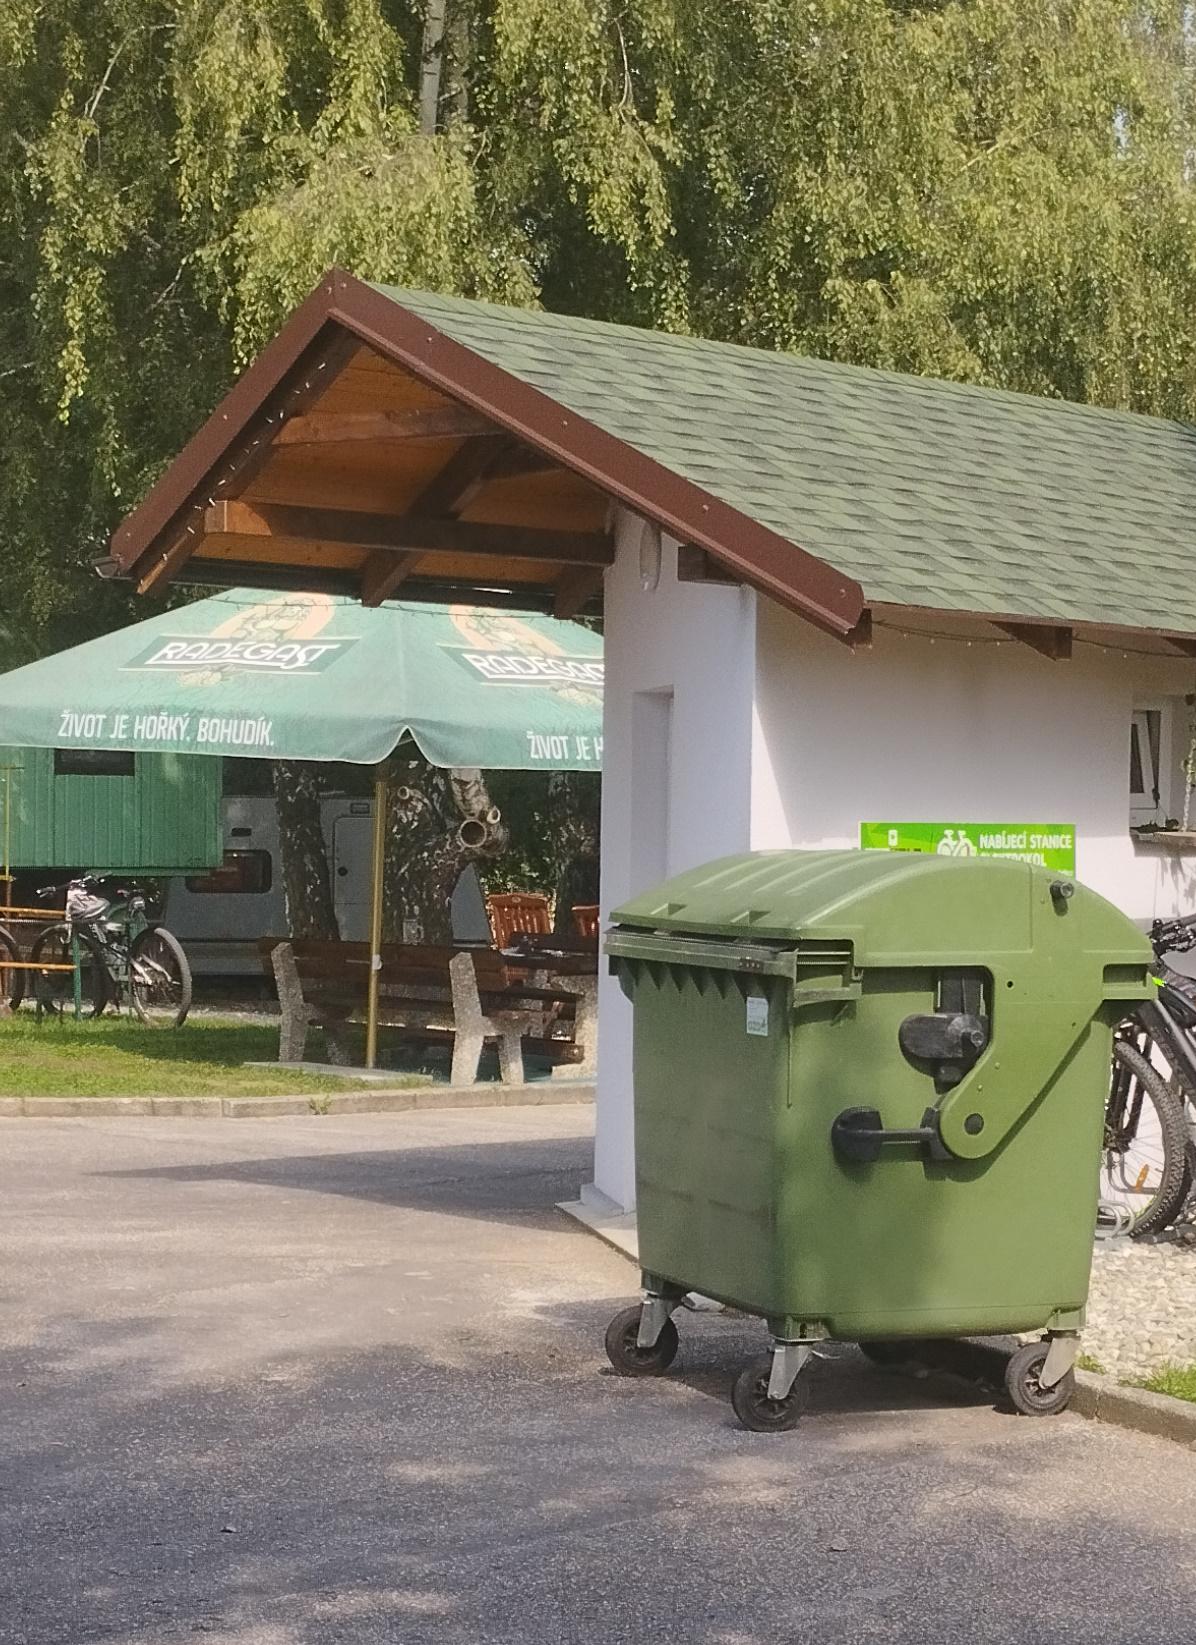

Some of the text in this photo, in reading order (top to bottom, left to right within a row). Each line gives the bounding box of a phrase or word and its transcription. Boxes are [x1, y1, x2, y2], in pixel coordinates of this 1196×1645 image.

[144, 642, 341, 670] RADEGAST
[461, 653, 604, 685] RADEGA
[58, 709, 274, 746] ŽIVOT JE HOŘKÝ. BOHUDÍK.
[526, 730, 568, 760] ŽIVOT
[576, 735, 591, 760] JE
[979, 830, 1072, 849] NABÍJECÍ STANICE
